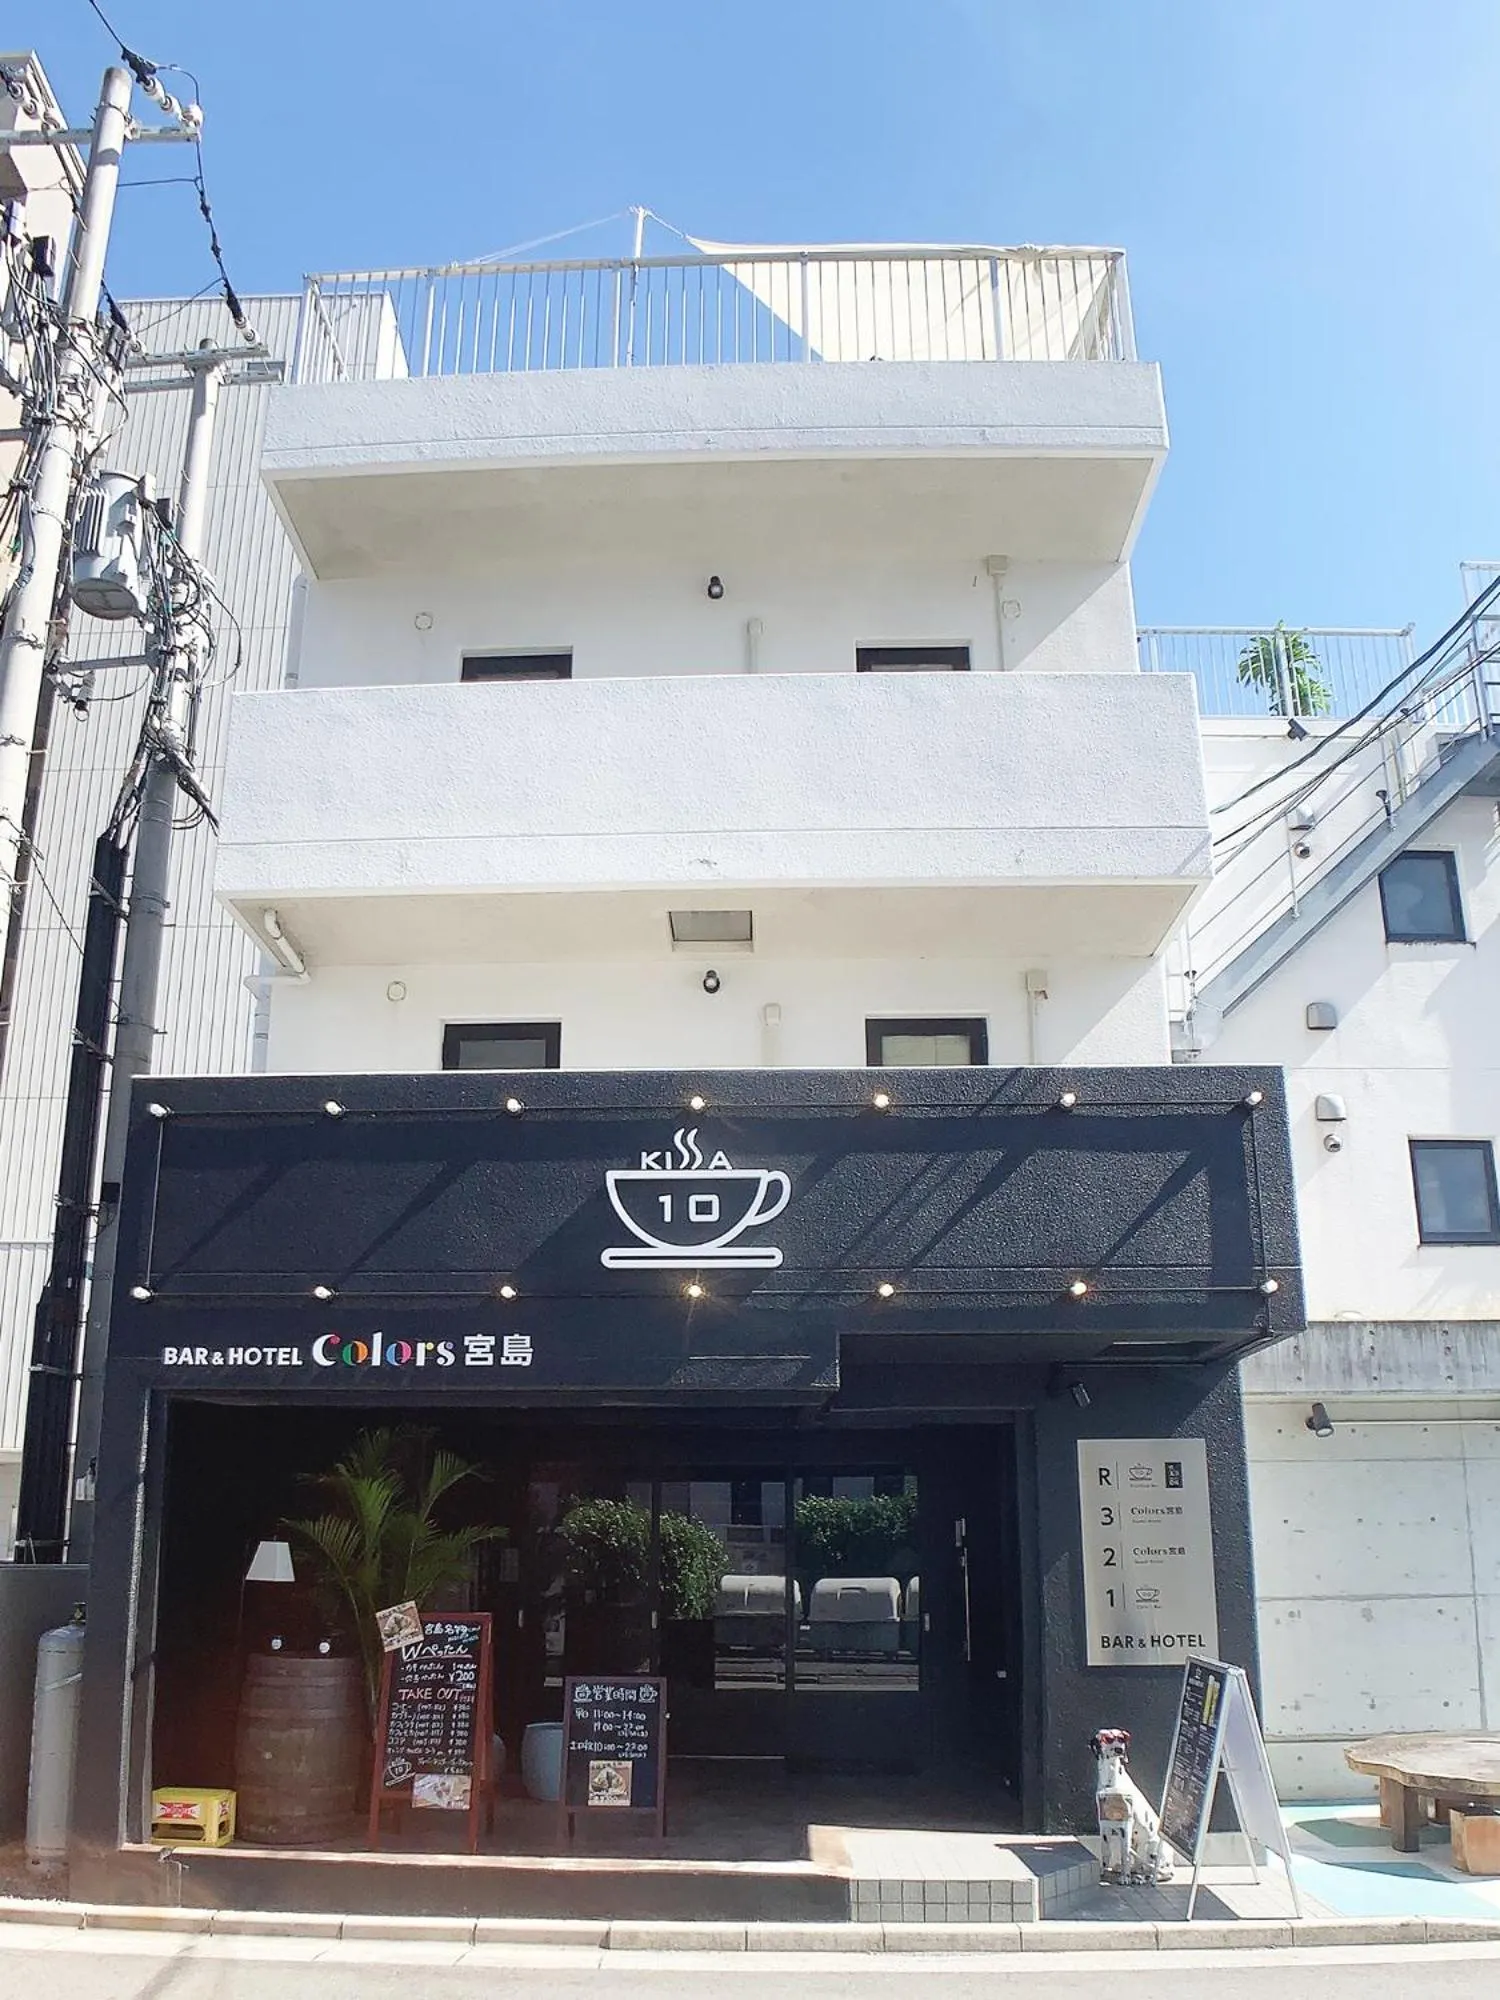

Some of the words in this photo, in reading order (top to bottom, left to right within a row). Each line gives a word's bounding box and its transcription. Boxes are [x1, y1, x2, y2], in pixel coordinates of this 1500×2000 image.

[658, 1194, 720, 1223] 10
[163, 1347, 208, 1365] BAR
[211, 1351, 224, 1365] &
[228, 1347, 303, 1366] HOTEL
[463, 1333, 534, 1367] 宮島
[1098, 1467, 1112, 1486] R
[1101, 1507, 1114, 1526] 3
[1103, 1547, 1117, 1567] 2
[1106, 1589, 1115, 1608] 1
[1101, 1636, 1134, 1649] BAR
[1138, 1639, 1146, 1648] &
[1151, 1634, 1206, 1648] HOTEL
[398, 1688, 433, 1701] TAKE
[437, 1687, 462, 1700] OUT
